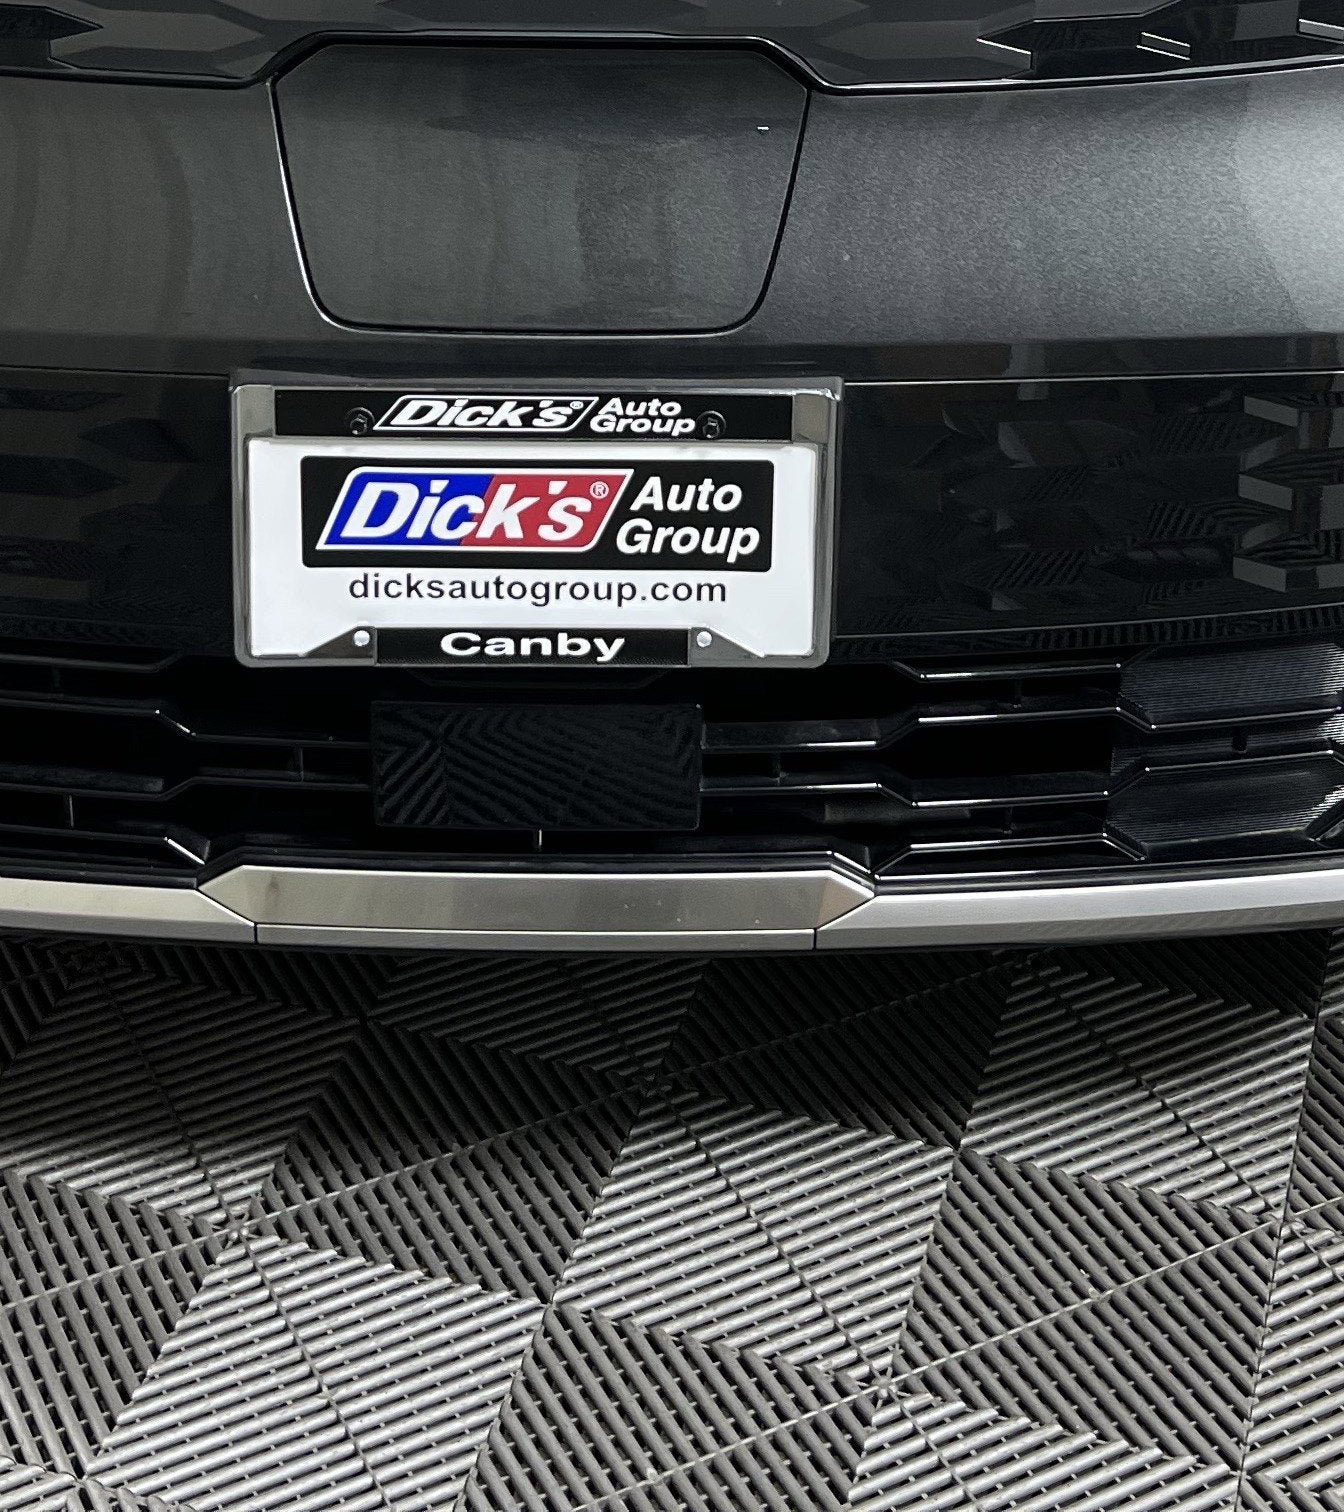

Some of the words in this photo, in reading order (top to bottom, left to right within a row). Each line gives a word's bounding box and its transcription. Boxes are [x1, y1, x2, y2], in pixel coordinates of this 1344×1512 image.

[596, 397, 682, 418] Auto
[589, 414, 696, 437] Group
[629, 476, 743, 514] Auto
[616, 518, 761, 564] Group
[348, 572, 728, 608] dicksautogroup.com
[439, 631, 626, 662] Canby
